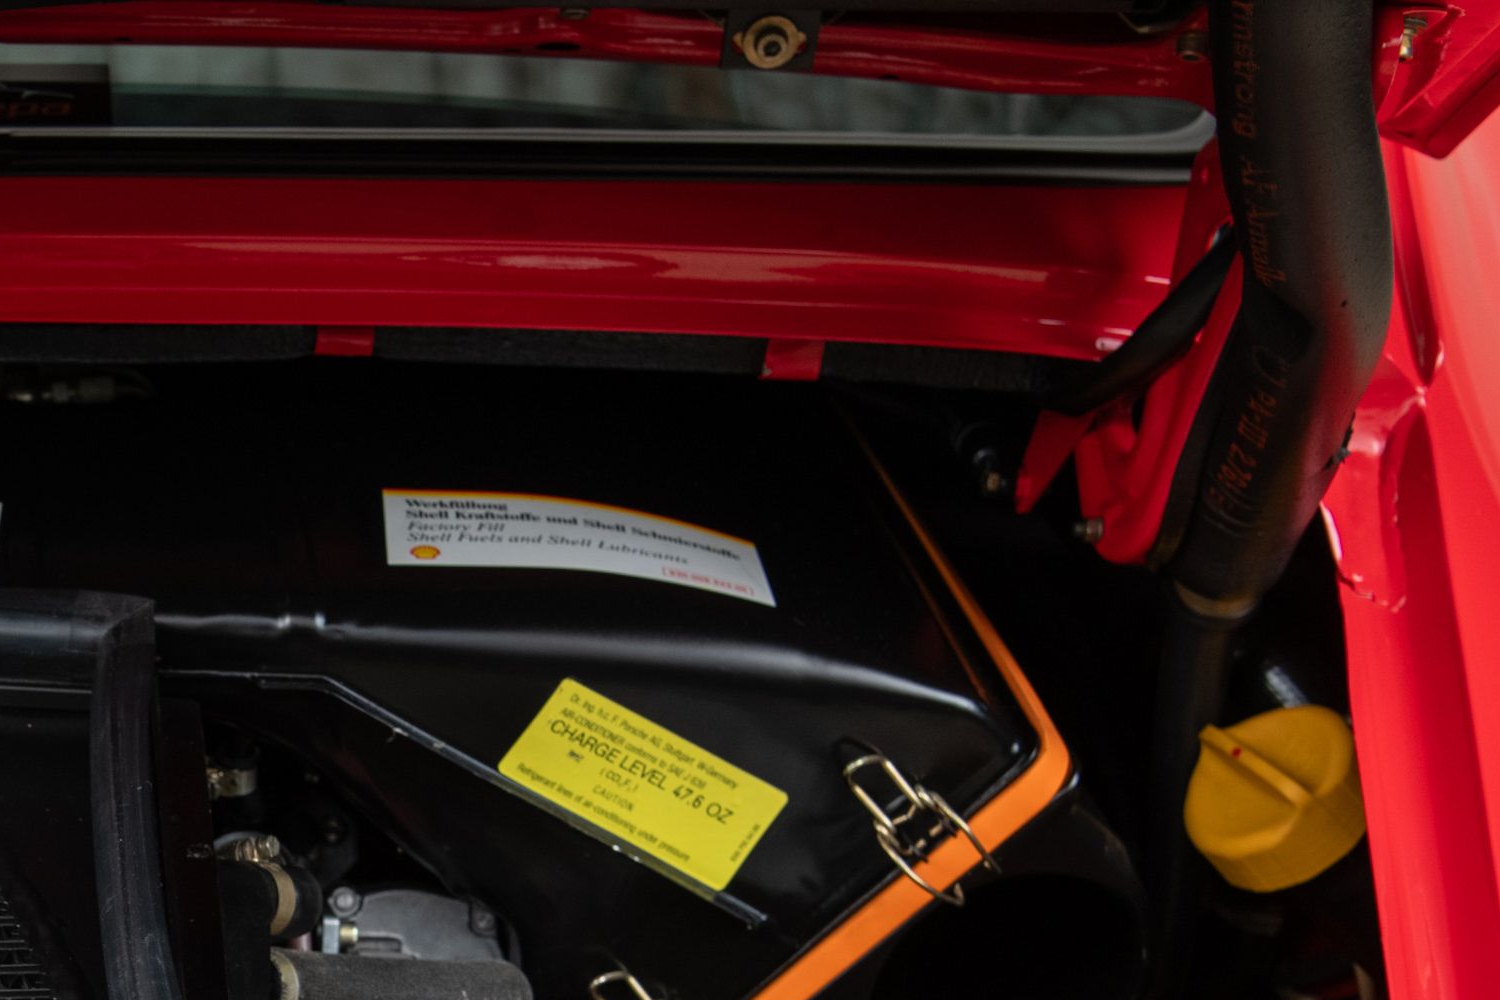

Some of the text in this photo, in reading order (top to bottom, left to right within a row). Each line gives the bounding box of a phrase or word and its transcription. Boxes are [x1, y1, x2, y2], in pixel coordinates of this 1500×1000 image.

[405, 510, 626, 533] Shell Kraftstoffe und Shell
[407, 520, 505, 534] Factory Fill
[406, 532, 689, 565] Shell Fuels and Shell Lubricants
[559, 706, 626, 747] AIR-CONDITIONER
[580, 700, 597, 715] Ing.
[618, 720, 649, 741] Porsche
[660, 743, 696, 768] Stuttgart
[548, 718, 734, 825] CHARGE LEVEL 47.6 OZ
[515, 762, 692, 864] Refrigerant lines of air-conditioning under pressure
[591, 783, 636, 812] CAUTION
